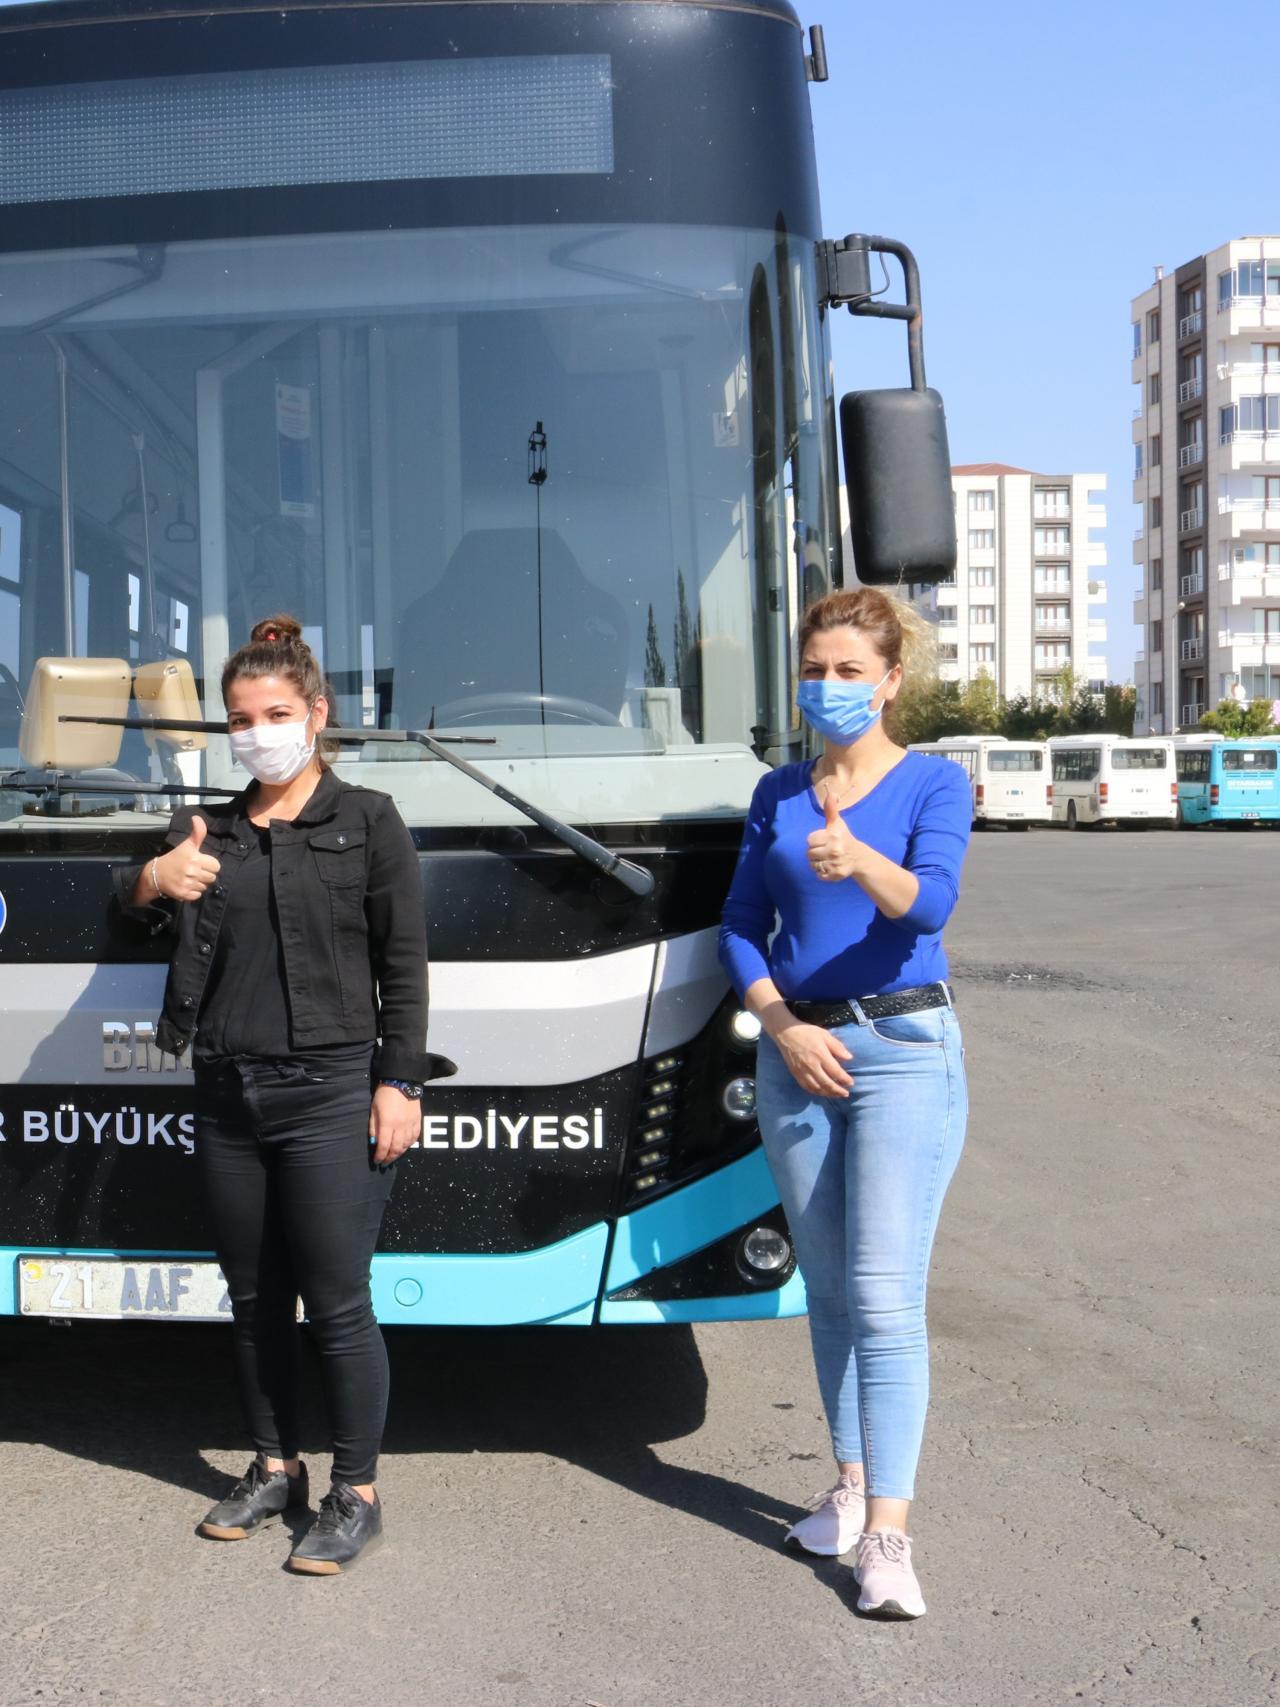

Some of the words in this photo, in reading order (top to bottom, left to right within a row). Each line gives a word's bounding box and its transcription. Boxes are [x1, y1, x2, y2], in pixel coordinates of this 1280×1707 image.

[410, 1107, 604, 1150] EDİYESİ
[49, 1264, 94, 1310] 21
[120, 1268, 193, 1311] AAF
